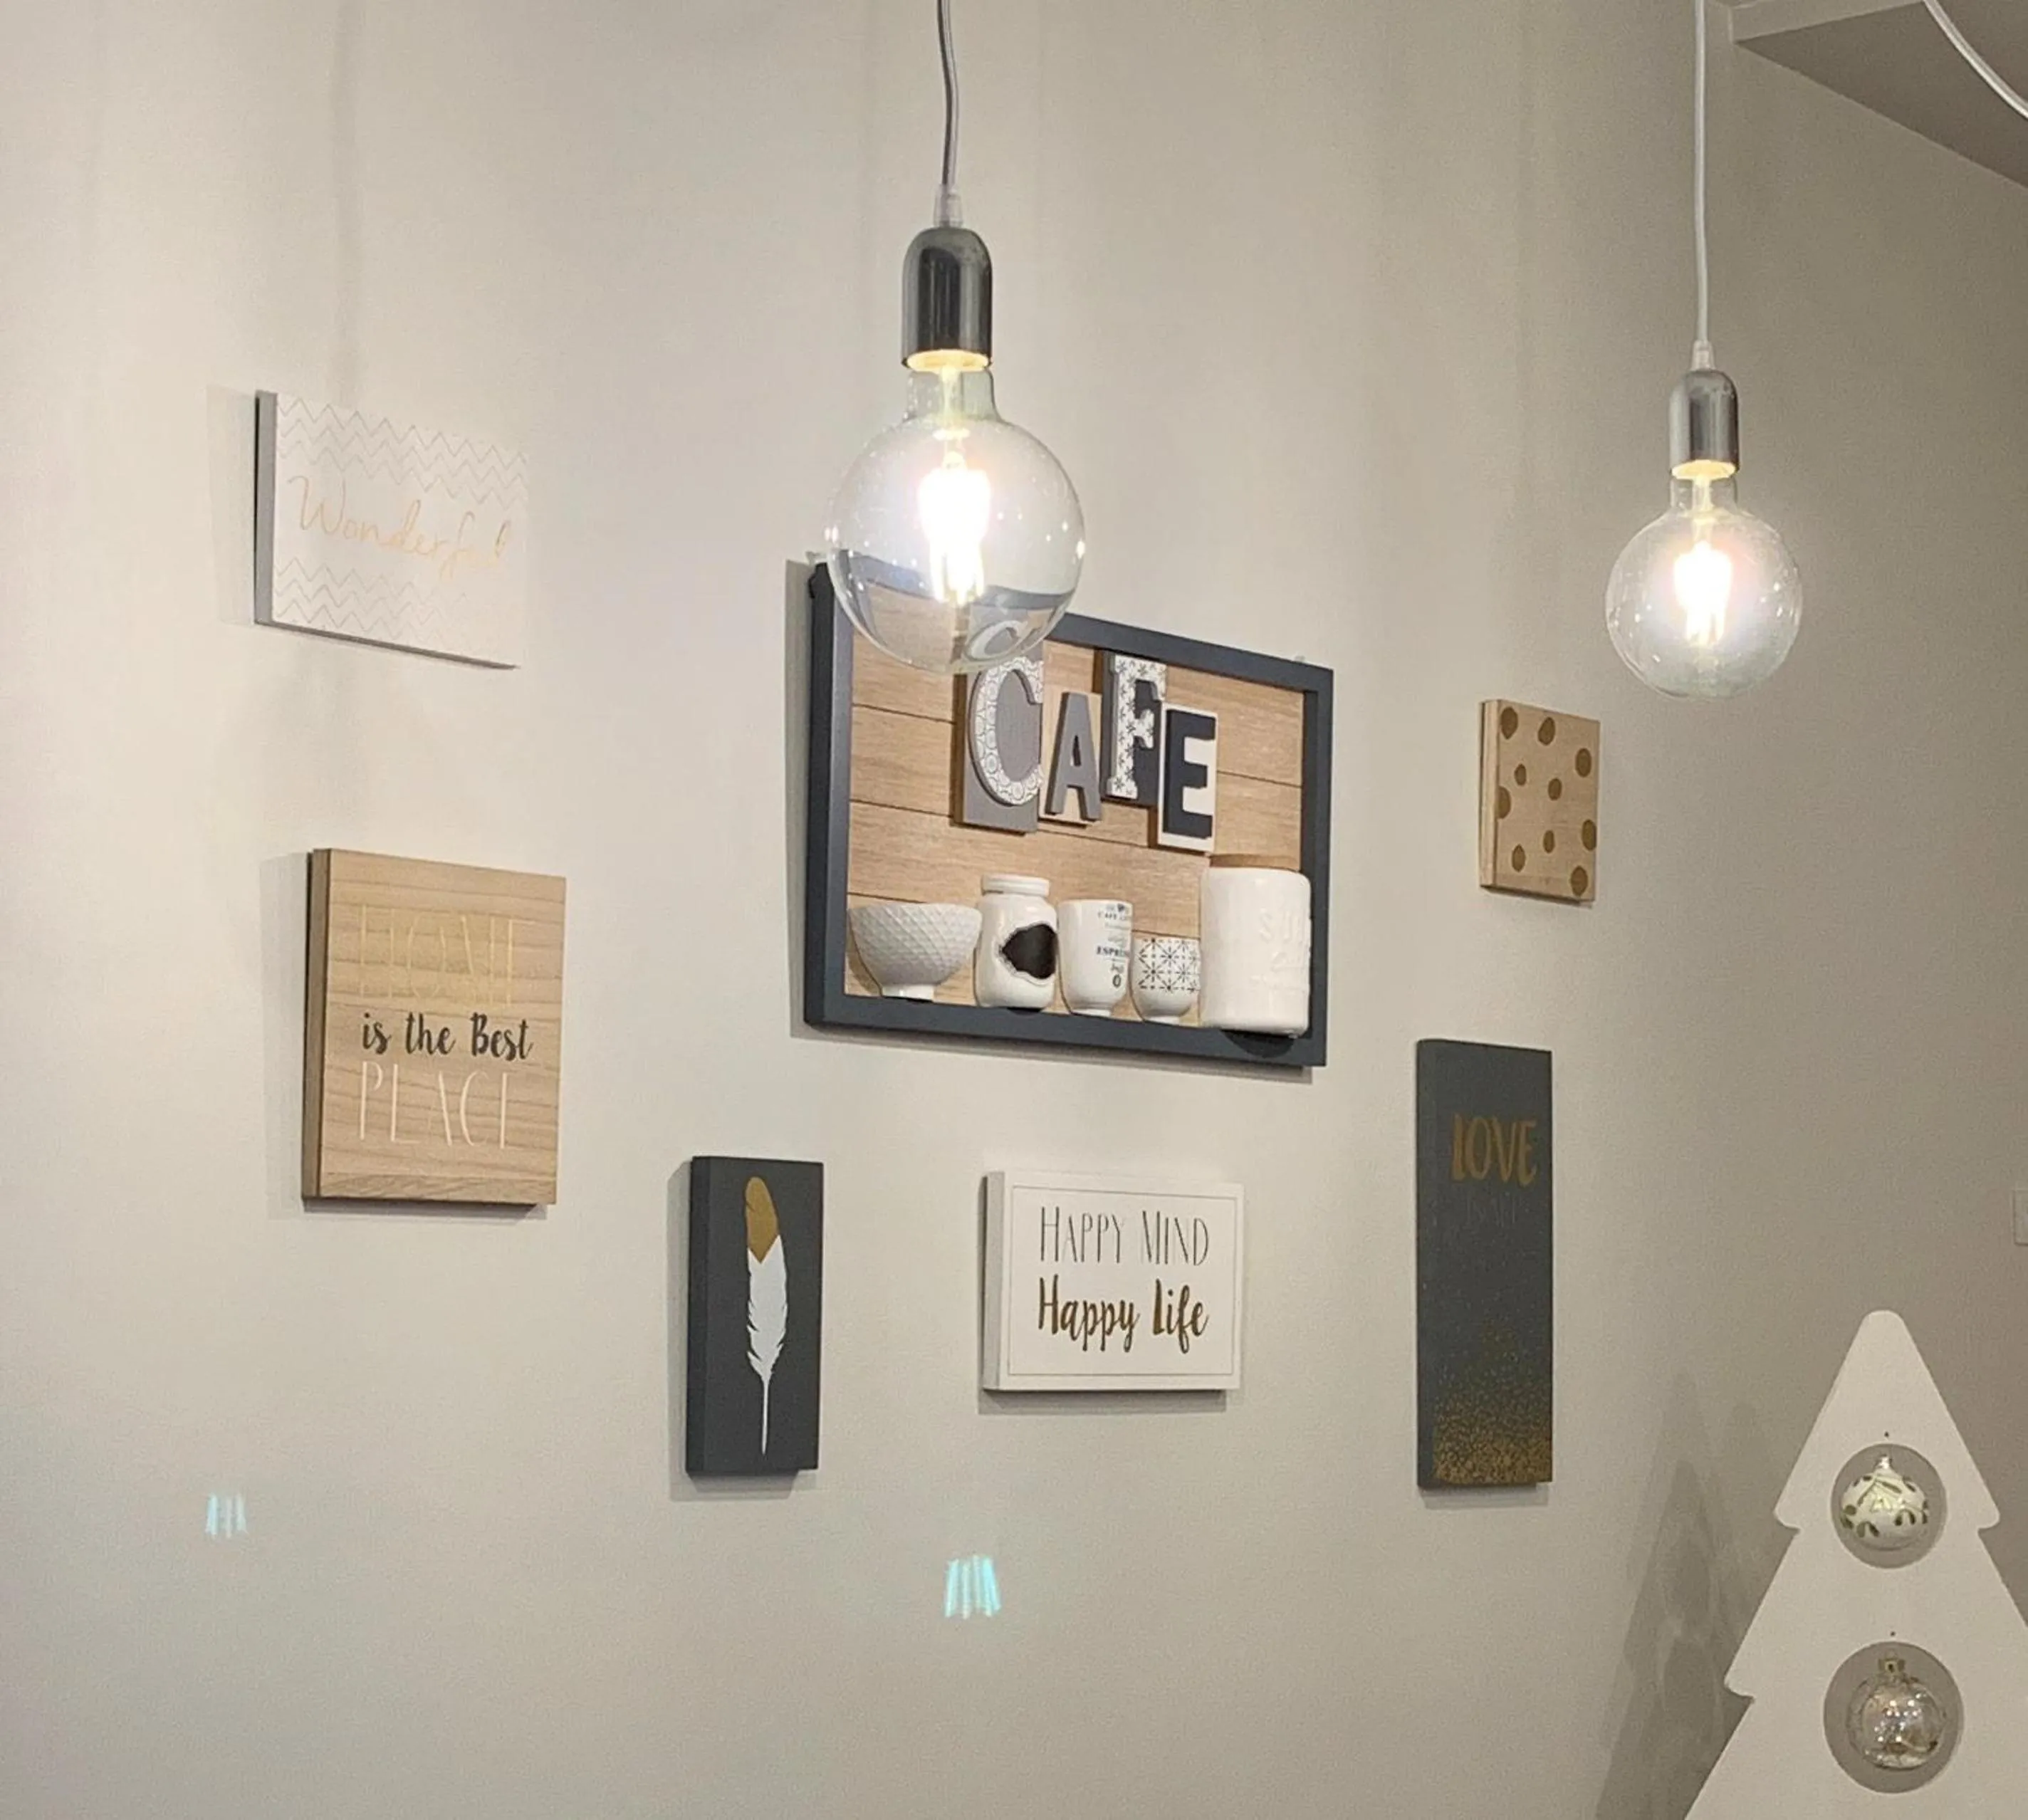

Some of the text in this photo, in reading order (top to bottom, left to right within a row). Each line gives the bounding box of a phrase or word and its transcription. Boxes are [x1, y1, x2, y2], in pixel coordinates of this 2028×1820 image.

[968, 654, 1216, 840] CAFE
[361, 1011, 534, 1062] is the Best
[1451, 1113, 1538, 1188] LOVE
[1040, 1206, 1209, 1266] HAPPY MIND
[1037, 1273, 1210, 1354] Happy Life
